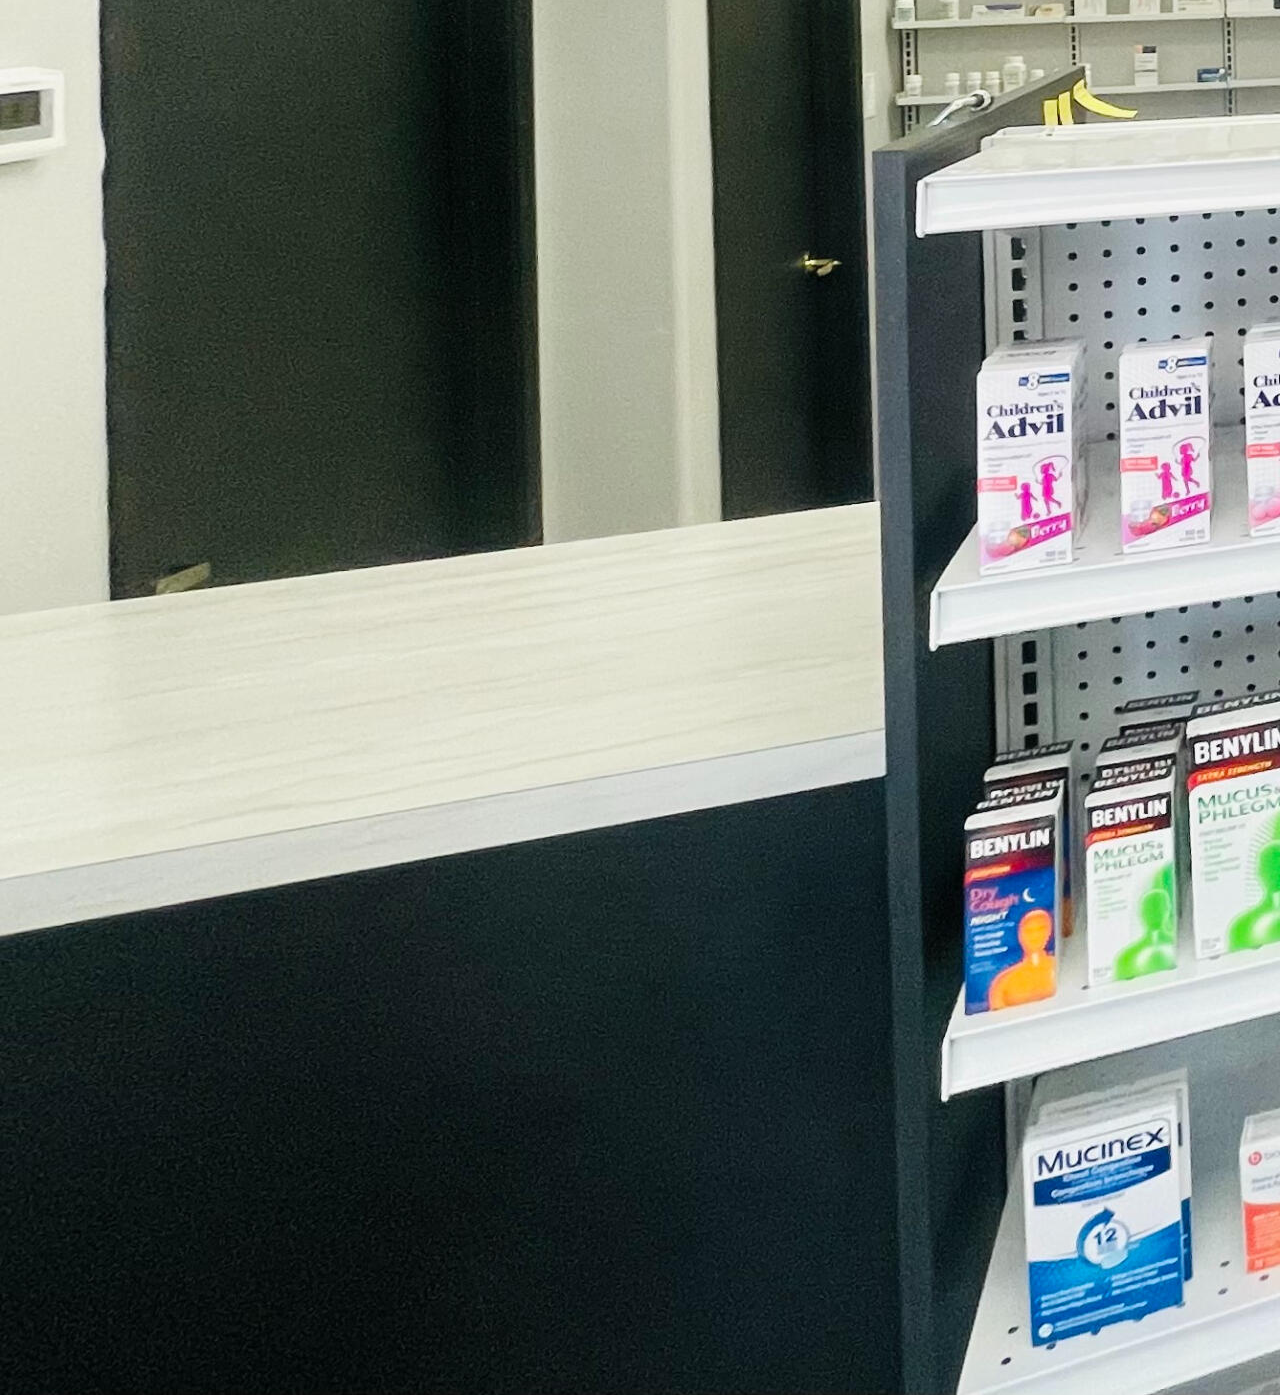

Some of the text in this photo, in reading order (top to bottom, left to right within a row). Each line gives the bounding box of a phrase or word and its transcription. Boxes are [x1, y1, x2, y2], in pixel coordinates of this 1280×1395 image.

[1127, 395, 1202, 422] Advil
[983, 413, 1065, 441] Advil
[1198, 785, 1272, 808] MUCUS
[1091, 797, 1167, 828] BENYLIN
[969, 829, 1051, 859] BENYLIN
[1093, 841, 1153, 861] MUCUS
[1094, 850, 1164, 873] PHLEGM
[1094, 1227, 1118, 1245] 12
